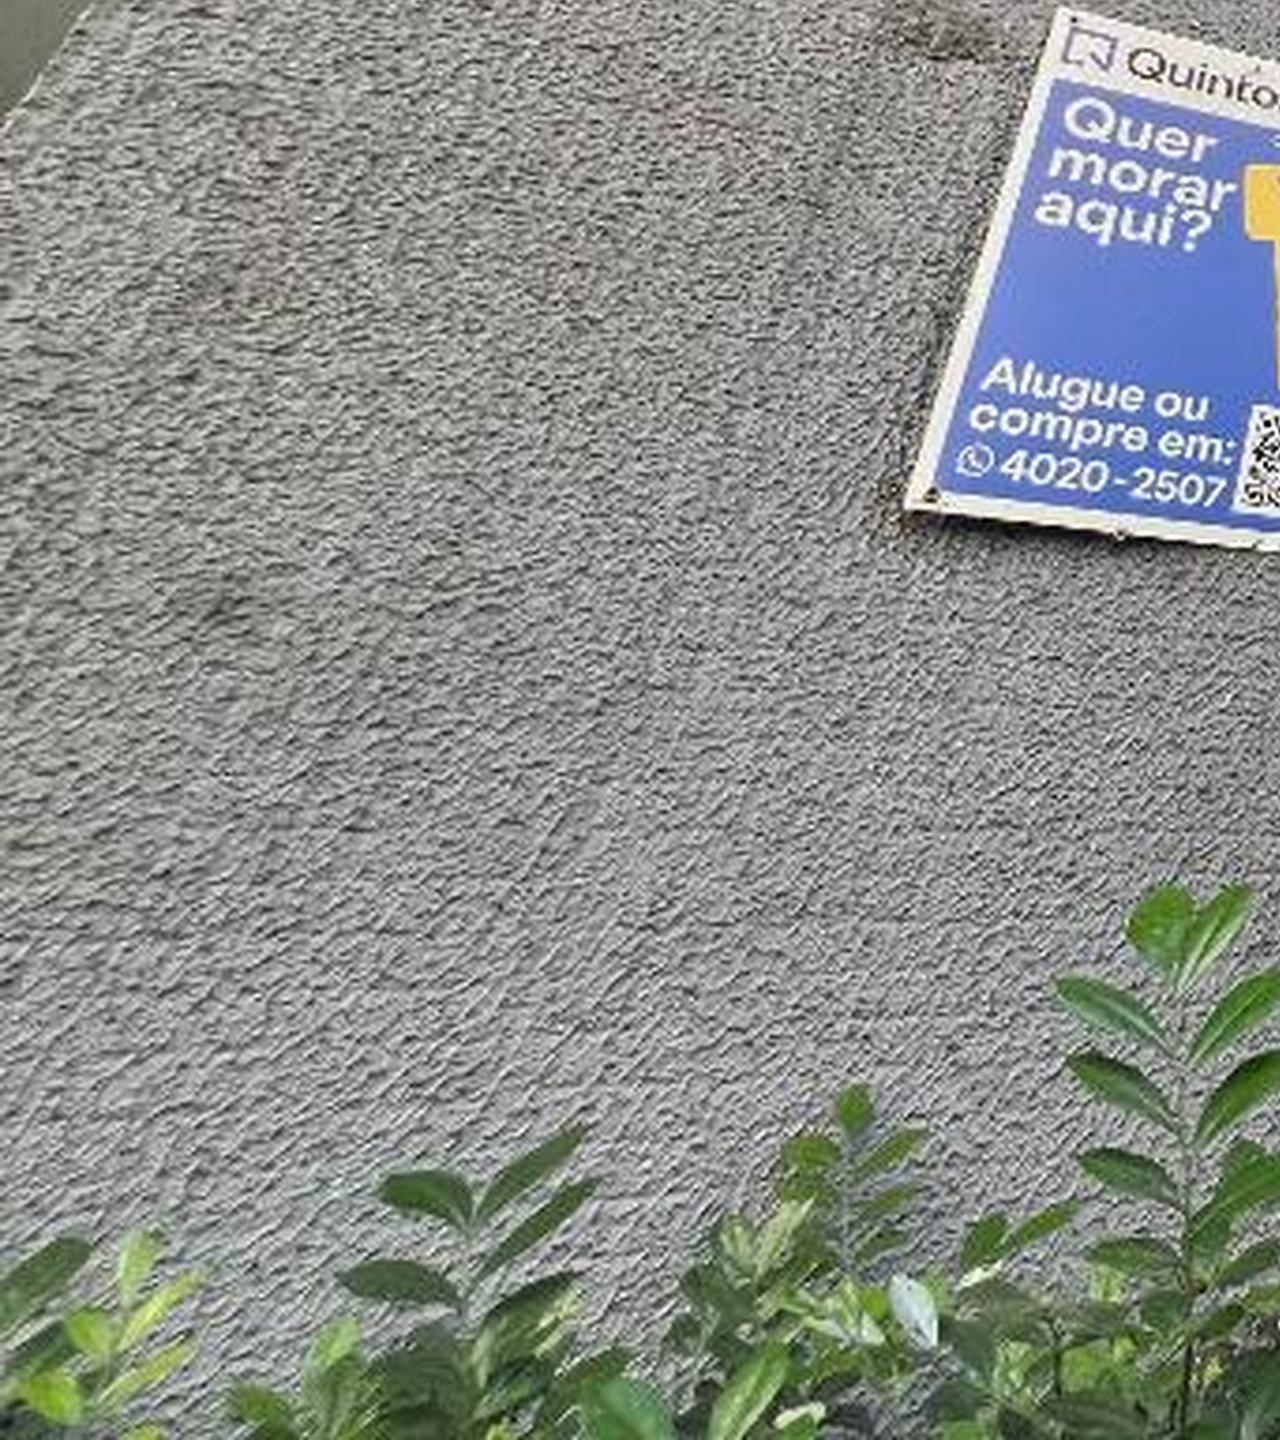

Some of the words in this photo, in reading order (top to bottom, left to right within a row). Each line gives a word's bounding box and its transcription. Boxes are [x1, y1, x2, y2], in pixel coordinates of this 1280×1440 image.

[1063, 97, 1219, 163] Quer
[1047, 147, 1239, 213] morar
[1034, 190, 1213, 252] aqui?
[980, 358, 1146, 414] Alugue
[1155, 386, 1209, 422] ou
[968, 402, 1149, 456] compre
[1158, 425, 1240, 466] em:
[1001, 451, 1228, 508] 4020-2507
